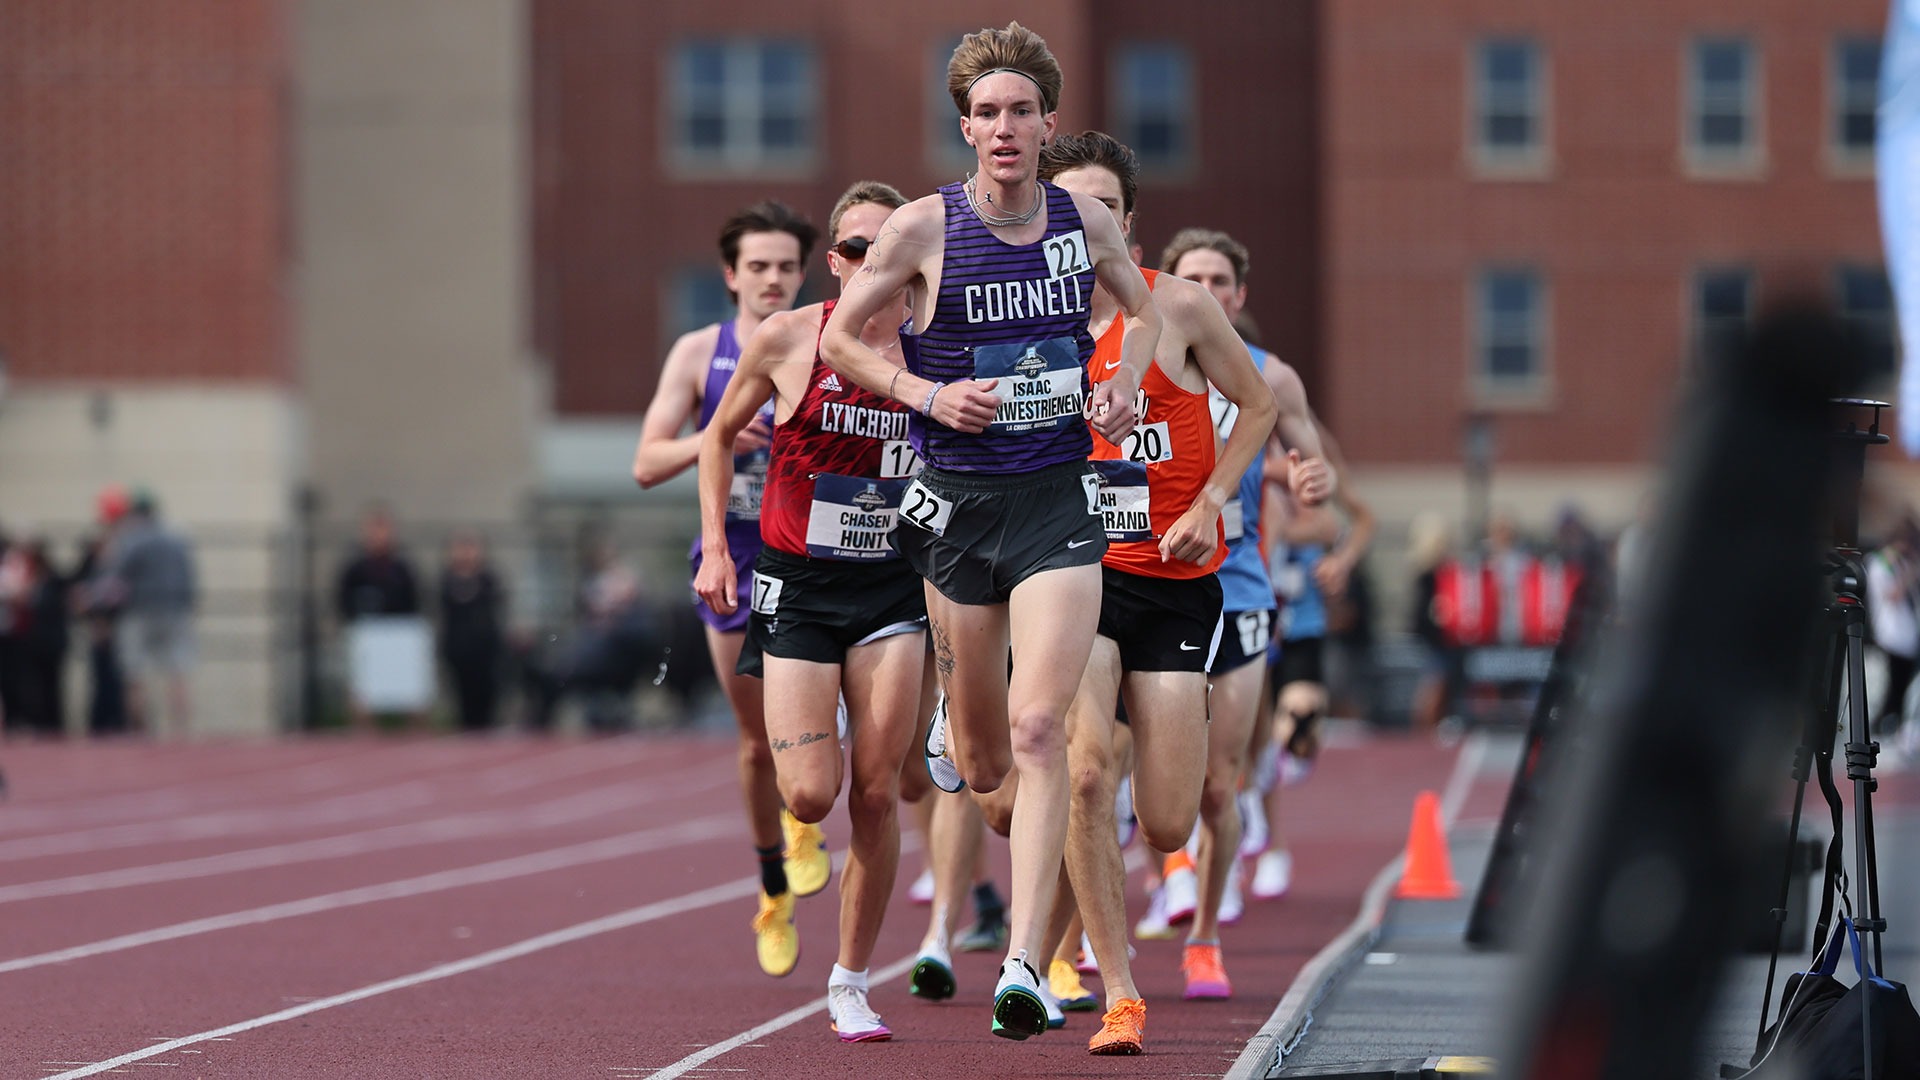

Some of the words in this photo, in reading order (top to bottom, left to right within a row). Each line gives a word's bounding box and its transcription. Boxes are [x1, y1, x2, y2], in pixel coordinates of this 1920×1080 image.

[1049, 238, 1082, 277] 22
[964, 277, 1086, 324] CORNELL
[818, 382, 843, 392] adidas
[1013, 379, 1052, 397] ISAAC
[991, 393, 1081, 422] NWESTRIENEN
[890, 444, 917, 476] 17
[1128, 428, 1162, 463] 20
[905, 488, 940, 531] 22
[1100, 493, 1117, 507] AH
[840, 512, 891, 528] CHASEN
[1102, 511, 1149, 530] RAND
[840, 530, 885, 549] HUNT
[753, 577, 772, 611] 17
